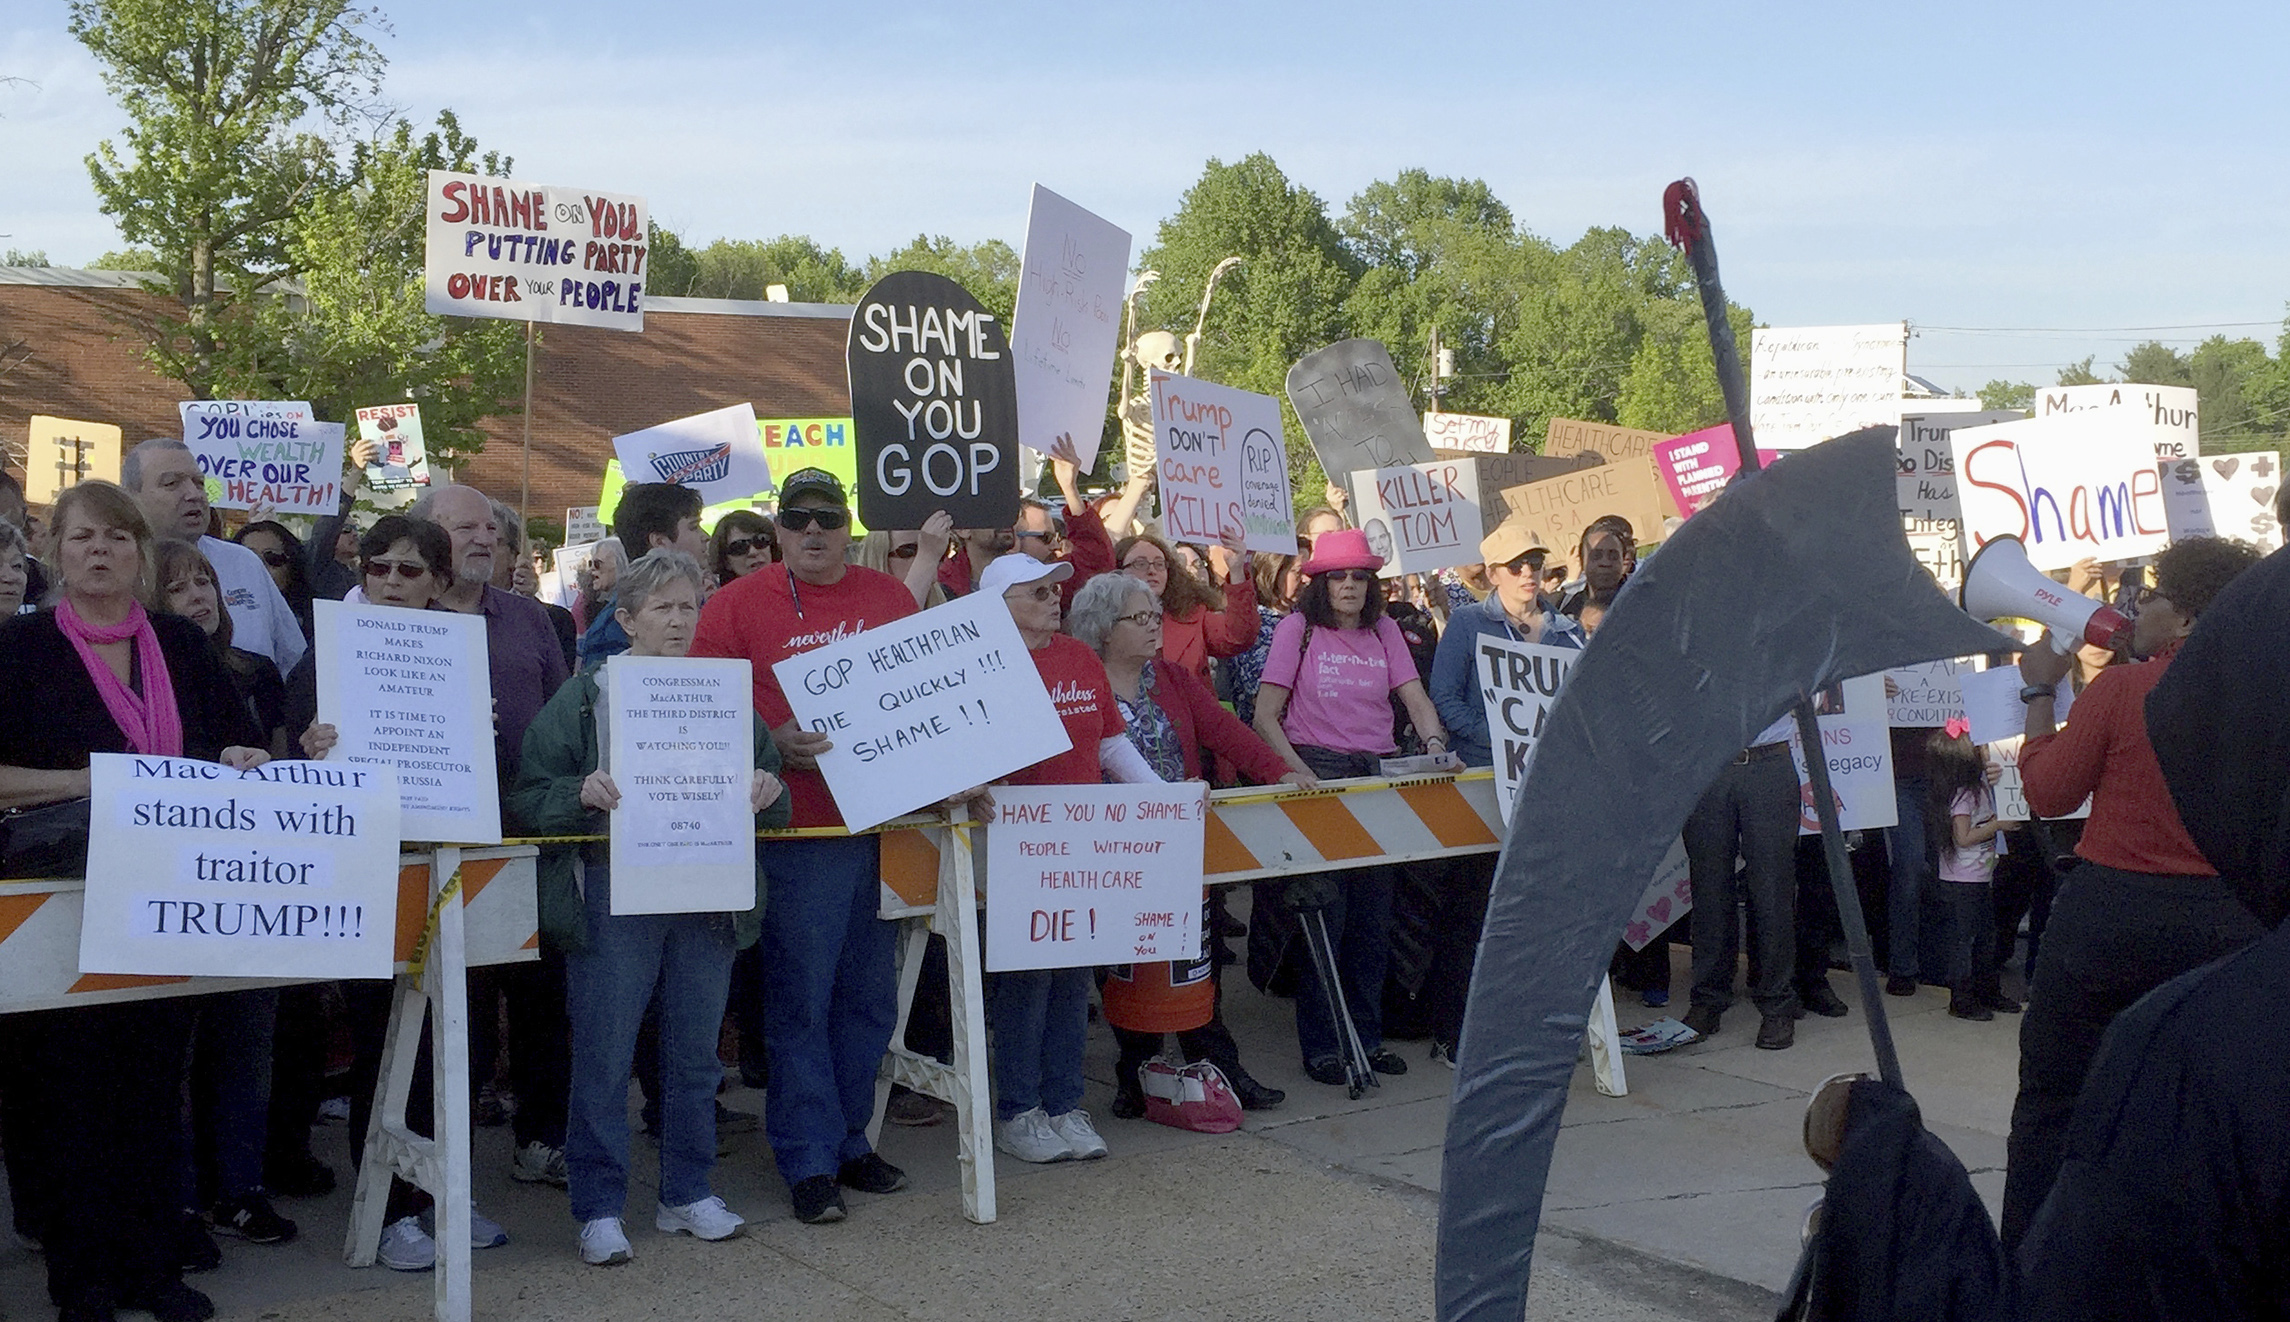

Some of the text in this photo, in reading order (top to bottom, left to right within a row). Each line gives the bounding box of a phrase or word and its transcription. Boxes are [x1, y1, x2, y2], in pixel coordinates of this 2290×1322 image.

[441, 181, 643, 241] SHAME ON YOU
[465, 231, 646, 275] PUTTING PARTY
[448, 273, 642, 313] OVER YOUR PEOPLE
[860, 302, 1000, 360] SHAME
[904, 357, 964, 397] ON
[1298, 362, 1388, 409] I HAD
[358, 405, 417, 422] RESIST
[893, 399, 982, 441] YOU
[1151, 376, 1233, 451] Trump
[197, 416, 241, 440] YOU
[246, 418, 300, 439] CHOSE
[758, 423, 845, 448] EACH
[236, 441, 326, 465] WEALTH
[1169, 426, 1220, 457] DON'T
[1354, 434, 1394, 466] TO
[1551, 424, 1658, 458] HEALTHCARE
[1668, 441, 1710, 462] I STAND
[197, 454, 311, 484] OVER OUR
[653, 451, 711, 479] COUNTRY
[681, 457, 727, 482] PARTY
[876, 443, 1000, 496] GOP
[1163, 457, 1223, 489] care
[1672, 457, 1699, 474] WITH
[1676, 464, 1725, 487] PLANNED
[228, 479, 335, 507] HEALTH!
[1376, 466, 1466, 511] KILLER
[1917, 480, 1954, 501] Has
[1965, 439, 2167, 547] Shame
[1165, 487, 1245, 541] KILLS
[1392, 507, 1458, 548] TOM
[2034, 587, 2064, 607] PYLE
[356, 618, 449, 636] DONALD TRUMP
[384, 637, 424, 649] MAKES
[356, 650, 453, 667] RICHARD NIXON
[364, 666, 446, 682] LOOK LIKE AN
[642, 677, 721, 687] CONGRESSMAN
[804, 658, 853, 695] GOP
[378, 683, 435, 697] AMATEUR
[650, 694, 714, 703] MacARTHUR
[811, 711, 852, 736] DIE
[878, 668, 967, 712] QUICKLY
[369, 709, 446, 724] IT IS TIME TO
[626, 709, 737, 719] THE THIRD DISTRICT
[373, 726, 445, 740] APPOINT AN
[678, 725, 689, 735] IS
[852, 715, 951, 762] SHAME
[368, 741, 451, 756] INDEPENDENT
[636, 741, 697, 751] WATCHING
[132, 759, 367, 789] Mac Arthur
[397, 759, 472, 773] PROSECUTOR
[1828, 754, 1883, 776] egacy
[402, 776, 443, 787] RUSSIA
[634, 773, 739, 785] THINK CAREFULLY!
[649, 792, 678, 801] VOTE
[133, 799, 357, 836] stands with
[1002, 803, 1053, 825] HAVE
[1064, 803, 1096, 823] YOU
[1104, 803, 1127, 823] NO
[1136, 801, 1191, 821] SHAME
[671, 821, 701, 830] 08740
[1019, 840, 1166, 857] PEOPLE WITHOUT
[195, 850, 315, 886] traitor
[148, 900, 363, 938] TRUMP!!!
[1030, 909, 1076, 943] DIE
[1134, 912, 1175, 928] SHAME
